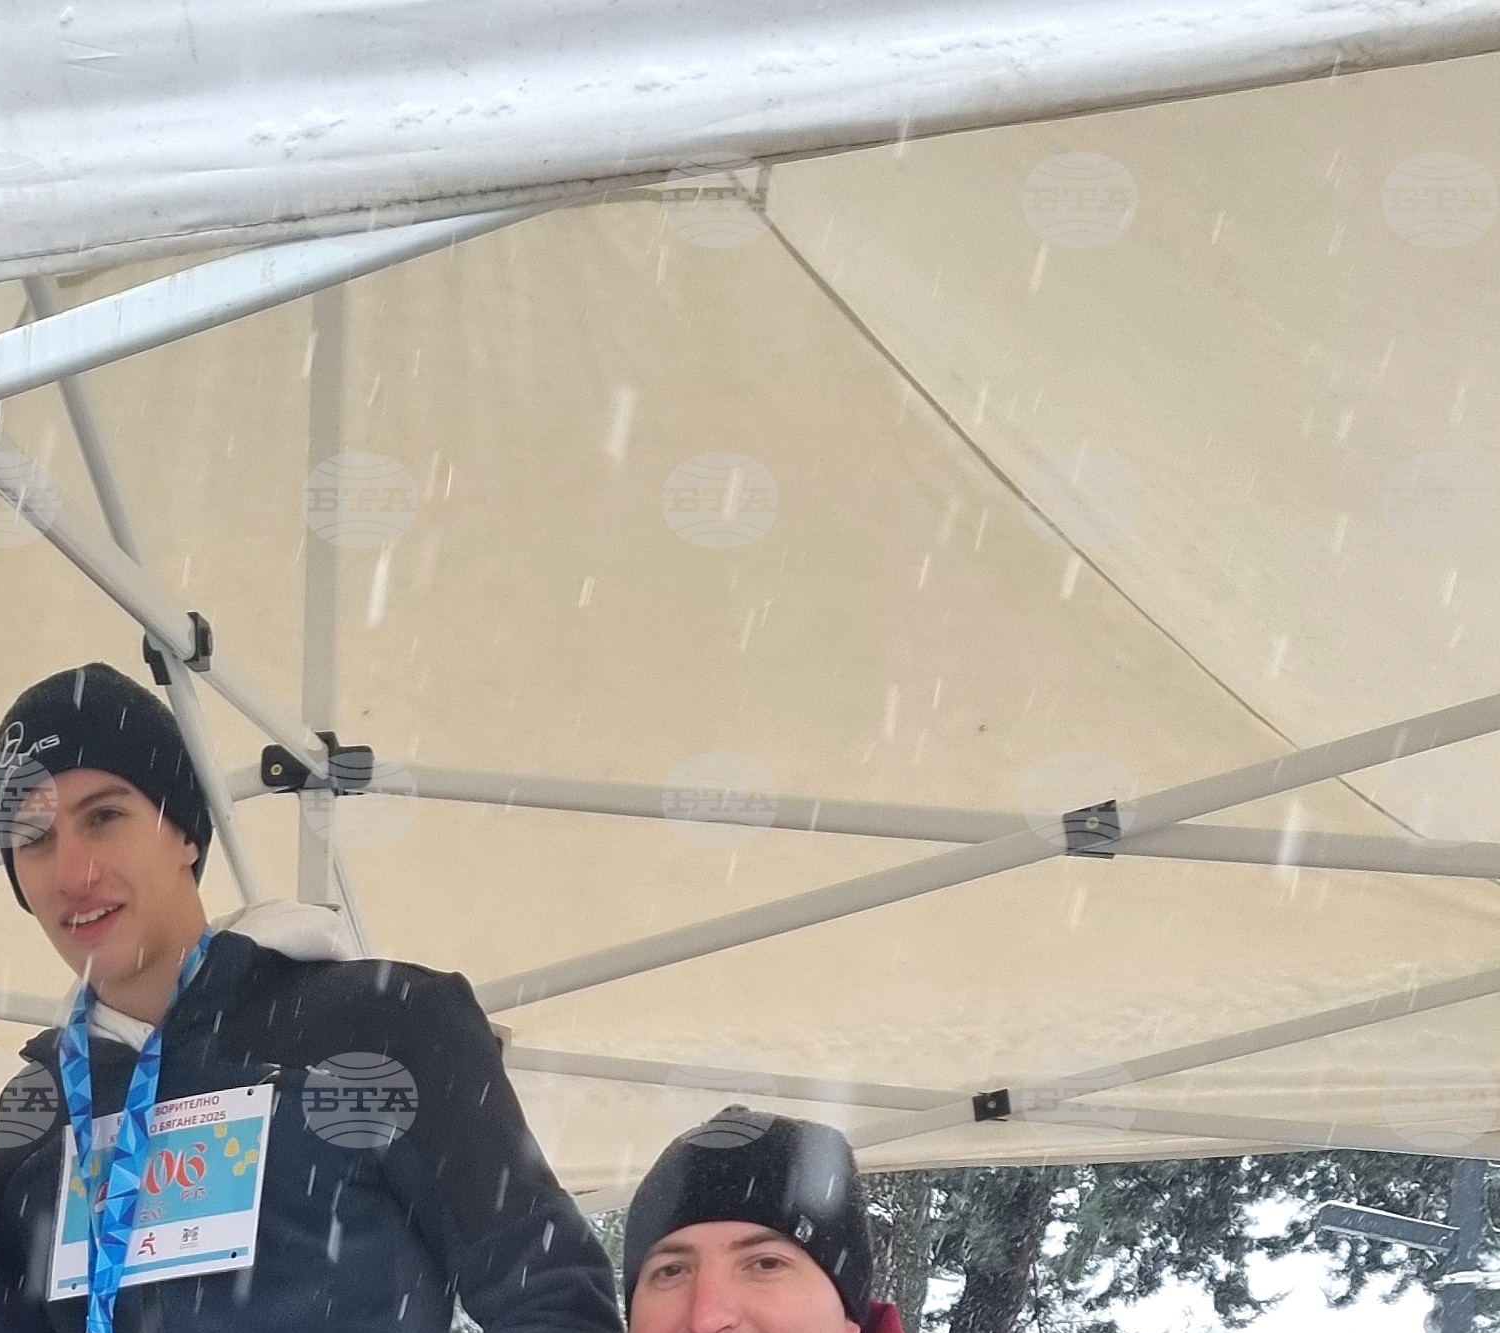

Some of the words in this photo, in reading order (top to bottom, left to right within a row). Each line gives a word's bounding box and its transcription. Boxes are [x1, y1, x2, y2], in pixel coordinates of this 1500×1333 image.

[160, 1116, 197, 1131] БЯГАНЕ
[200, 1111, 226, 1123] 2025
[144, 1142, 208, 1195] 06
